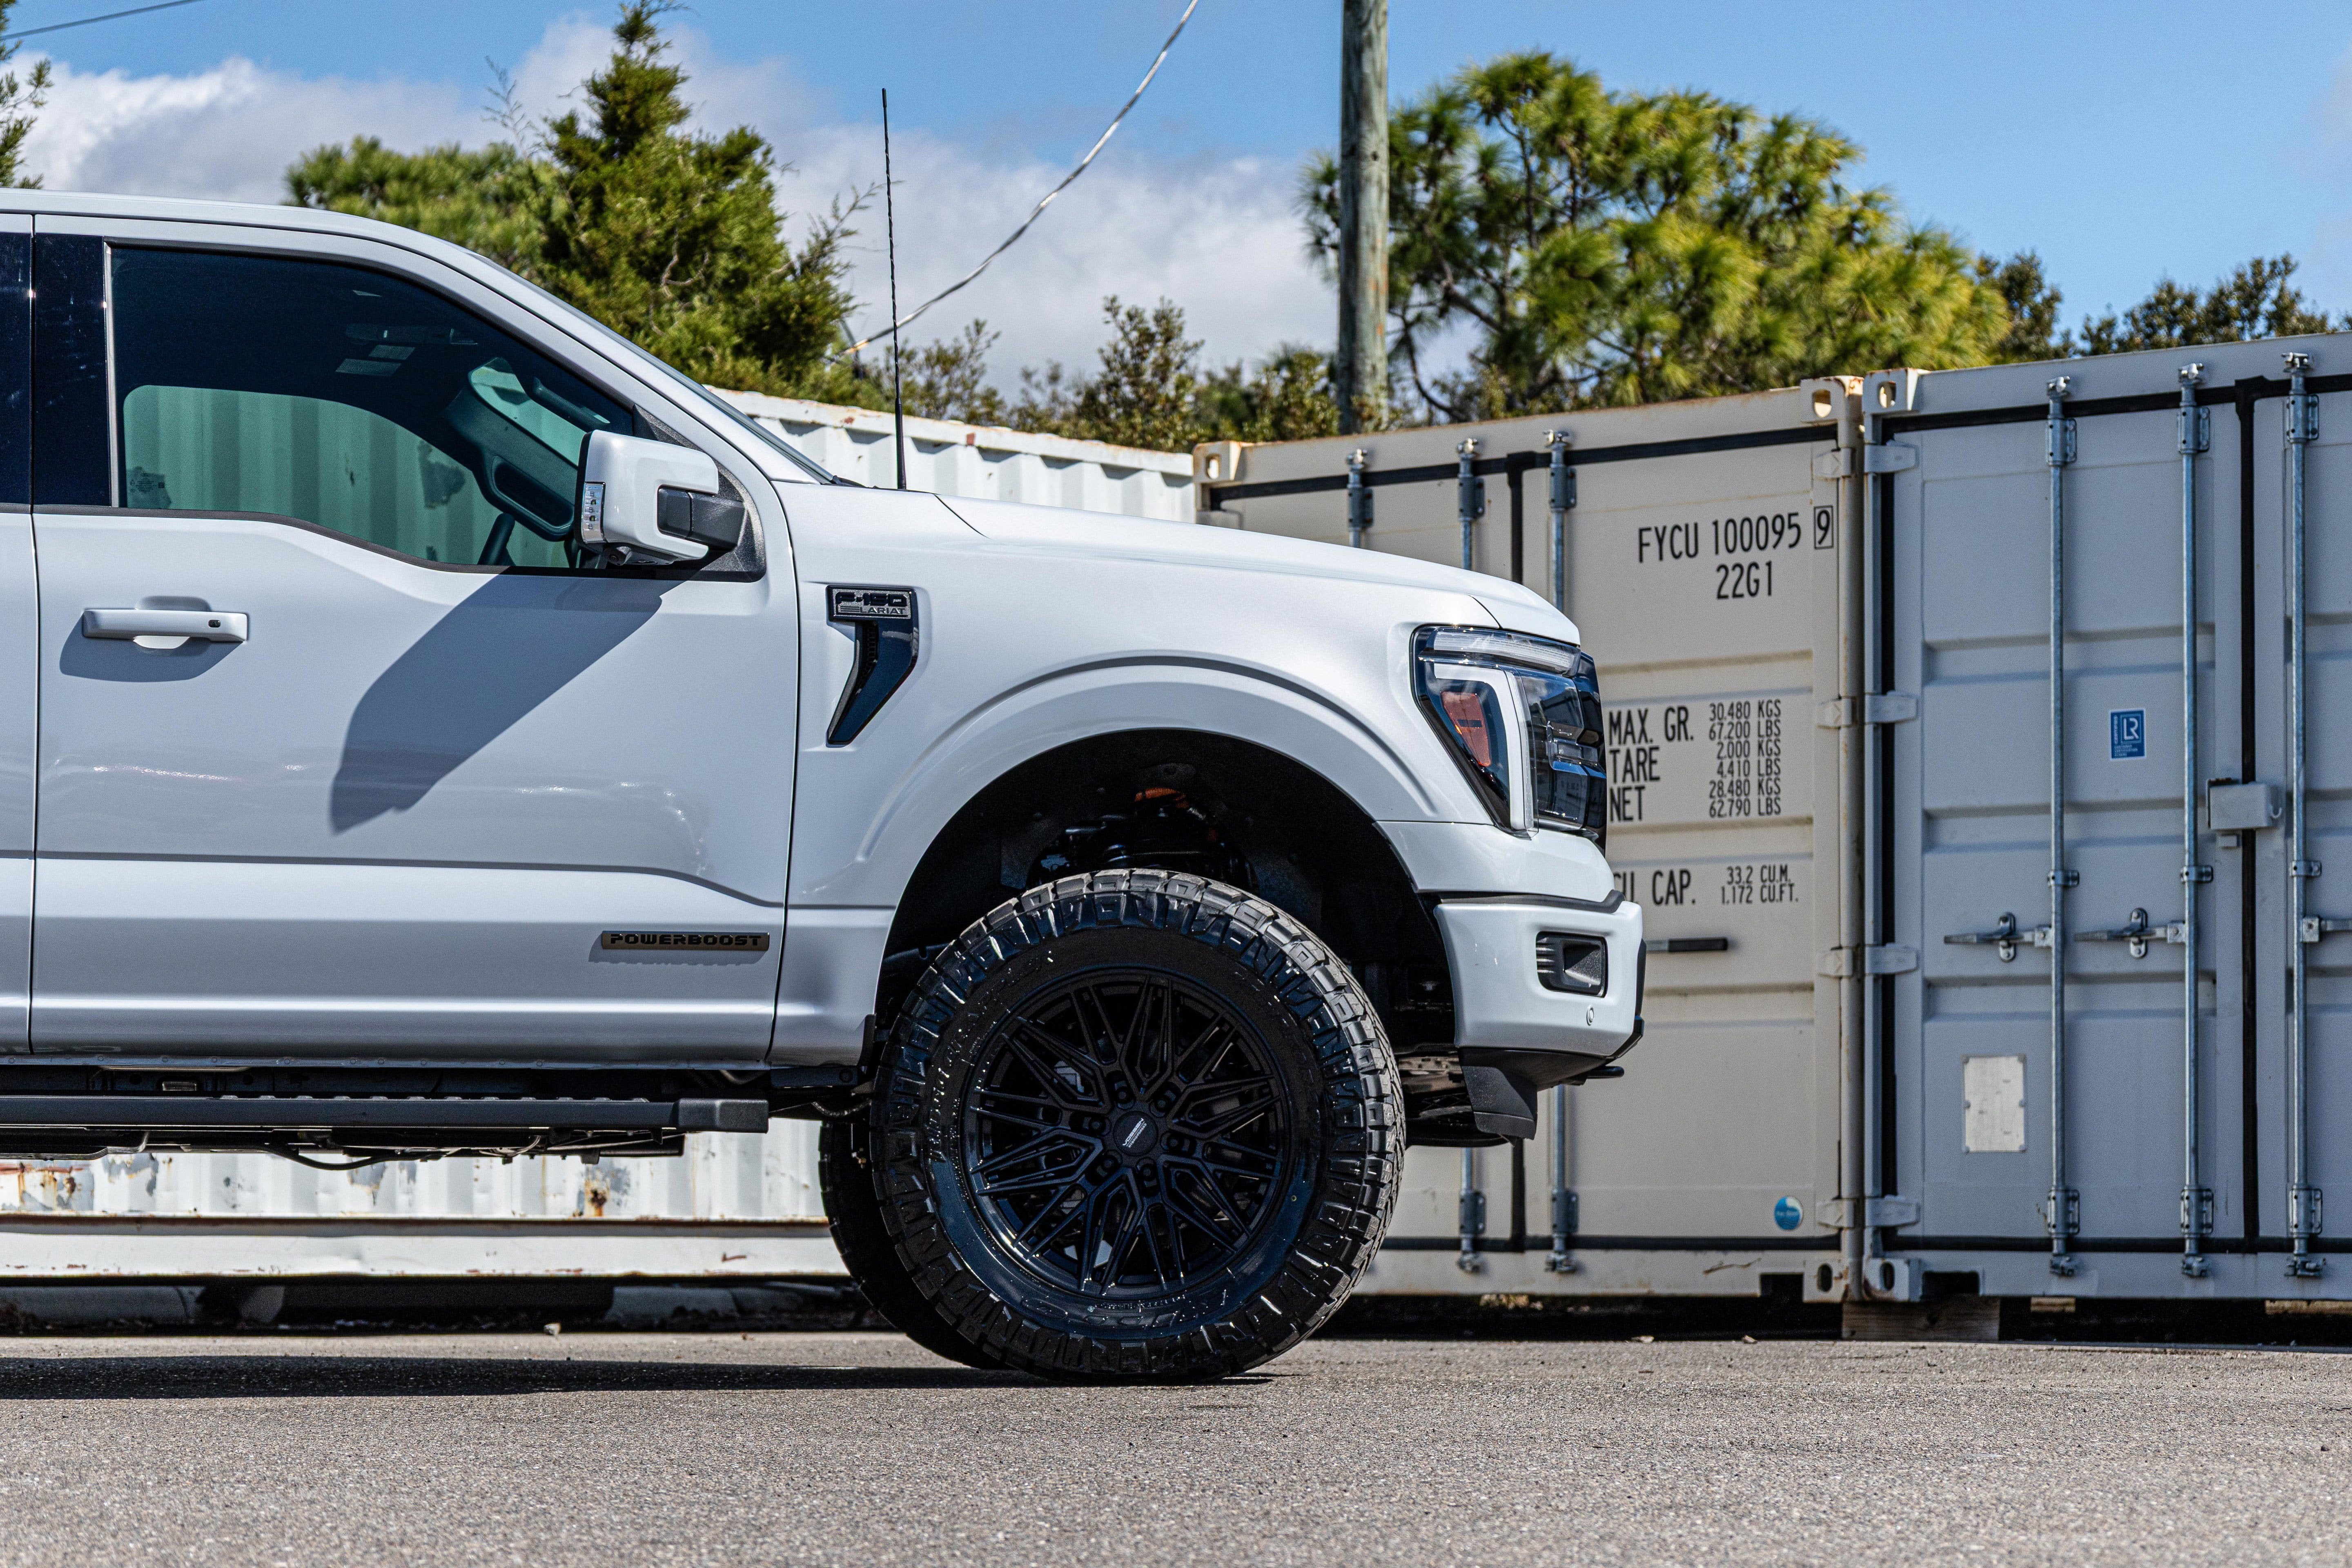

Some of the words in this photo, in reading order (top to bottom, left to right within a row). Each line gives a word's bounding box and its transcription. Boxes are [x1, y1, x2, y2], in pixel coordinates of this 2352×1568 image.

[1638, 522, 1699, 564] FYCU
[1712, 512, 1802, 555] 100095
[1817, 510, 1831, 545] 9
[1716, 561, 1772, 599] 22G1
[835, 592, 907, 606] F-150
[1608, 708, 1653, 745] MAX.
[1664, 705, 1694, 742] GR.
[1709, 701, 1751, 721] 30.480
[1757, 699, 1781, 718] KGS
[1709, 721, 1751, 741] 67.200
[1757, 719, 1781, 738] LBS
[2123, 717, 2140, 740] LR
[1609, 746, 1661, 784] TARE
[1717, 740, 1751, 760] 2.000
[1757, 739, 1781, 757] KGS
[1717, 760, 1751, 777] 4.410
[1757, 758, 1781, 776] LBS
[1610, 786, 1646, 822] NET
[1709, 780, 1751, 799] 28.480
[1757, 777, 1781, 796] KGS
[1709, 798, 1751, 818] 62.790
[1757, 796, 1781, 815] LBS
[1652, 868, 1696, 906] CAP.
[1727, 865, 1753, 885] 33.2
[1721, 885, 1753, 904] 1.172
[610, 933, 762, 946] POWERBOOST
[1122, 1118, 1144, 1146] VOSSEN
